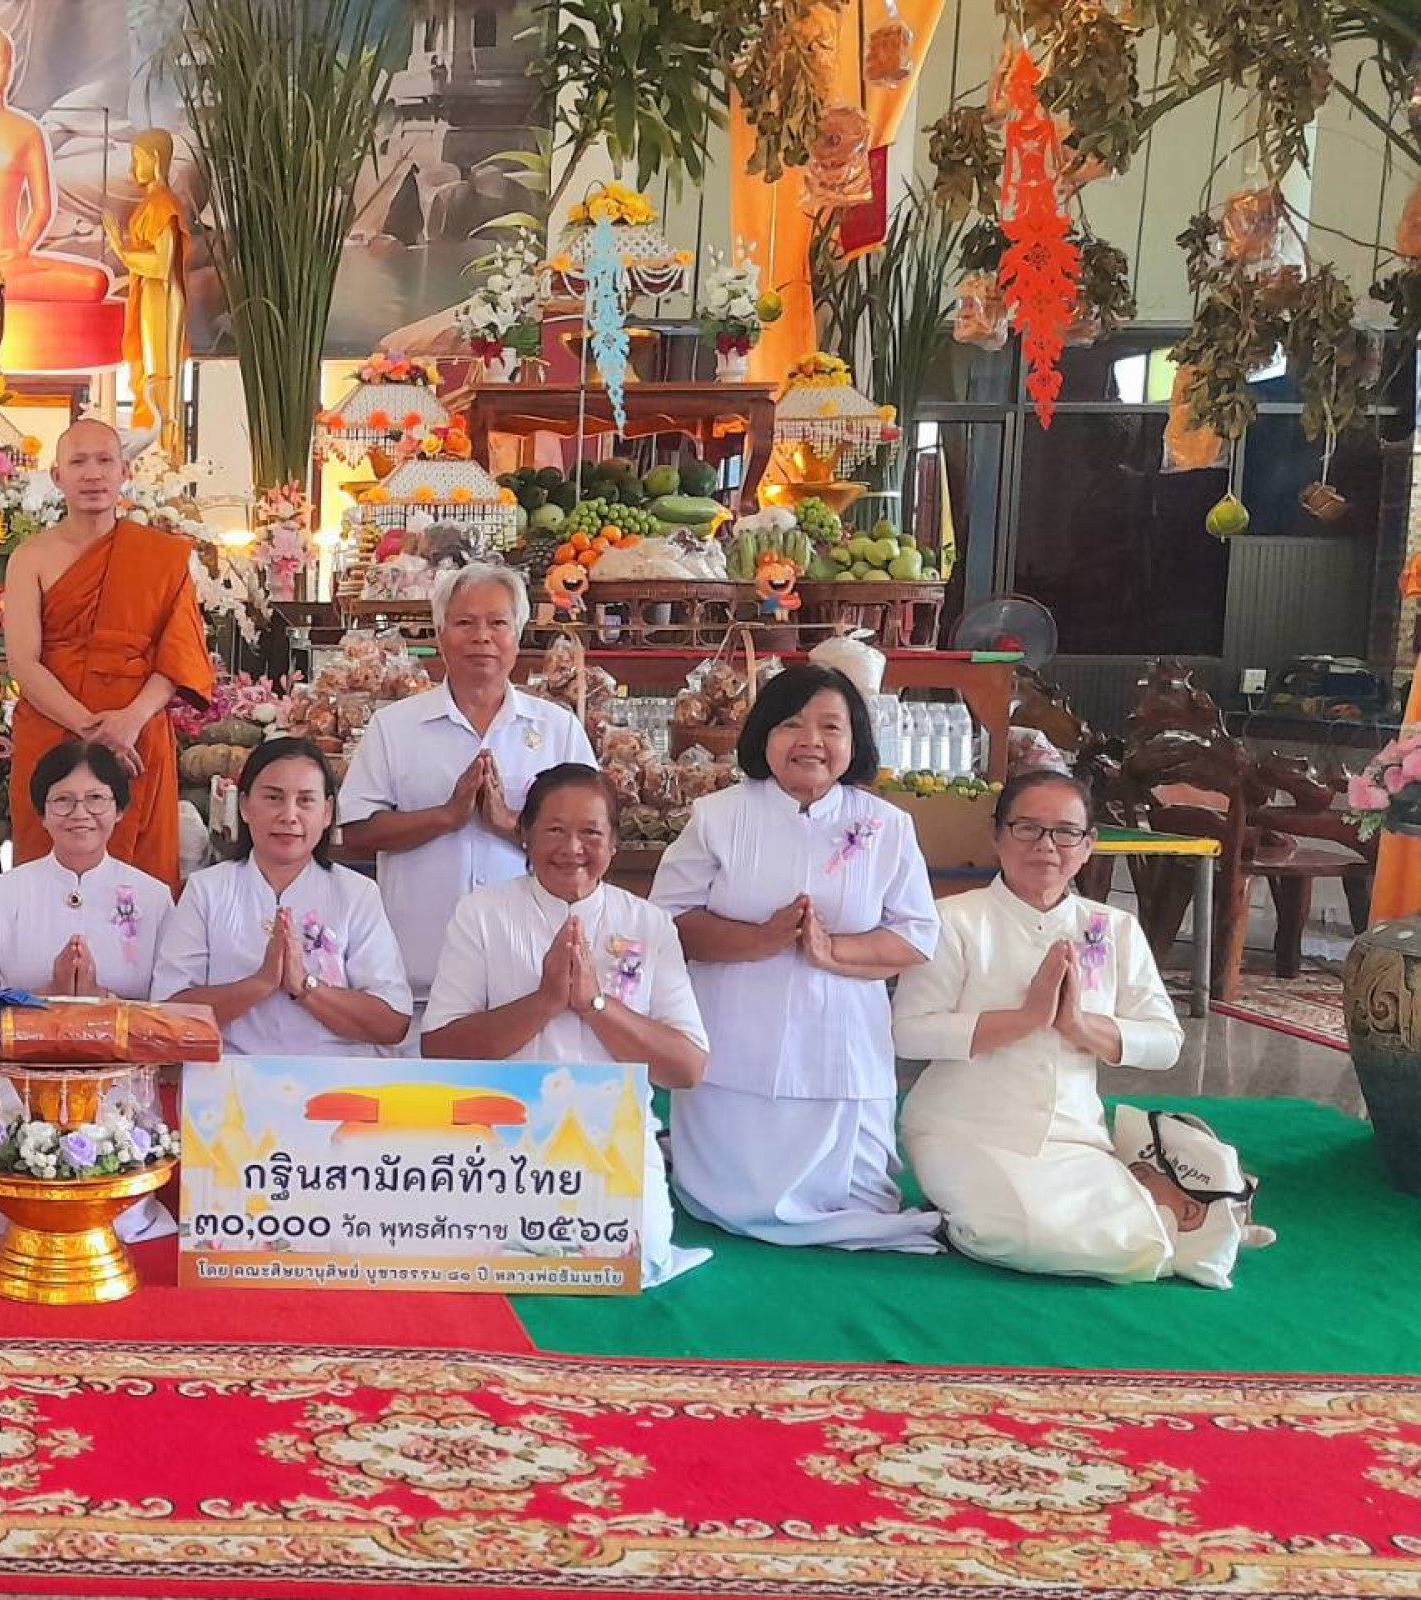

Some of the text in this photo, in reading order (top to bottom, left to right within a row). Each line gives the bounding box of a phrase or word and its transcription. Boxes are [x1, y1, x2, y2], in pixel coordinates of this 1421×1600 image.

[244, 1145, 582, 1201] กฐินสามัคคีทั่วไทย
[195, 1213, 629, 1247] ๓๐,๐๐๐ วัด พุทธศักราช ๒๕๖๘
[197, 1258, 227, 1278] โดย
[477, 1265, 490, 1282] ปี
